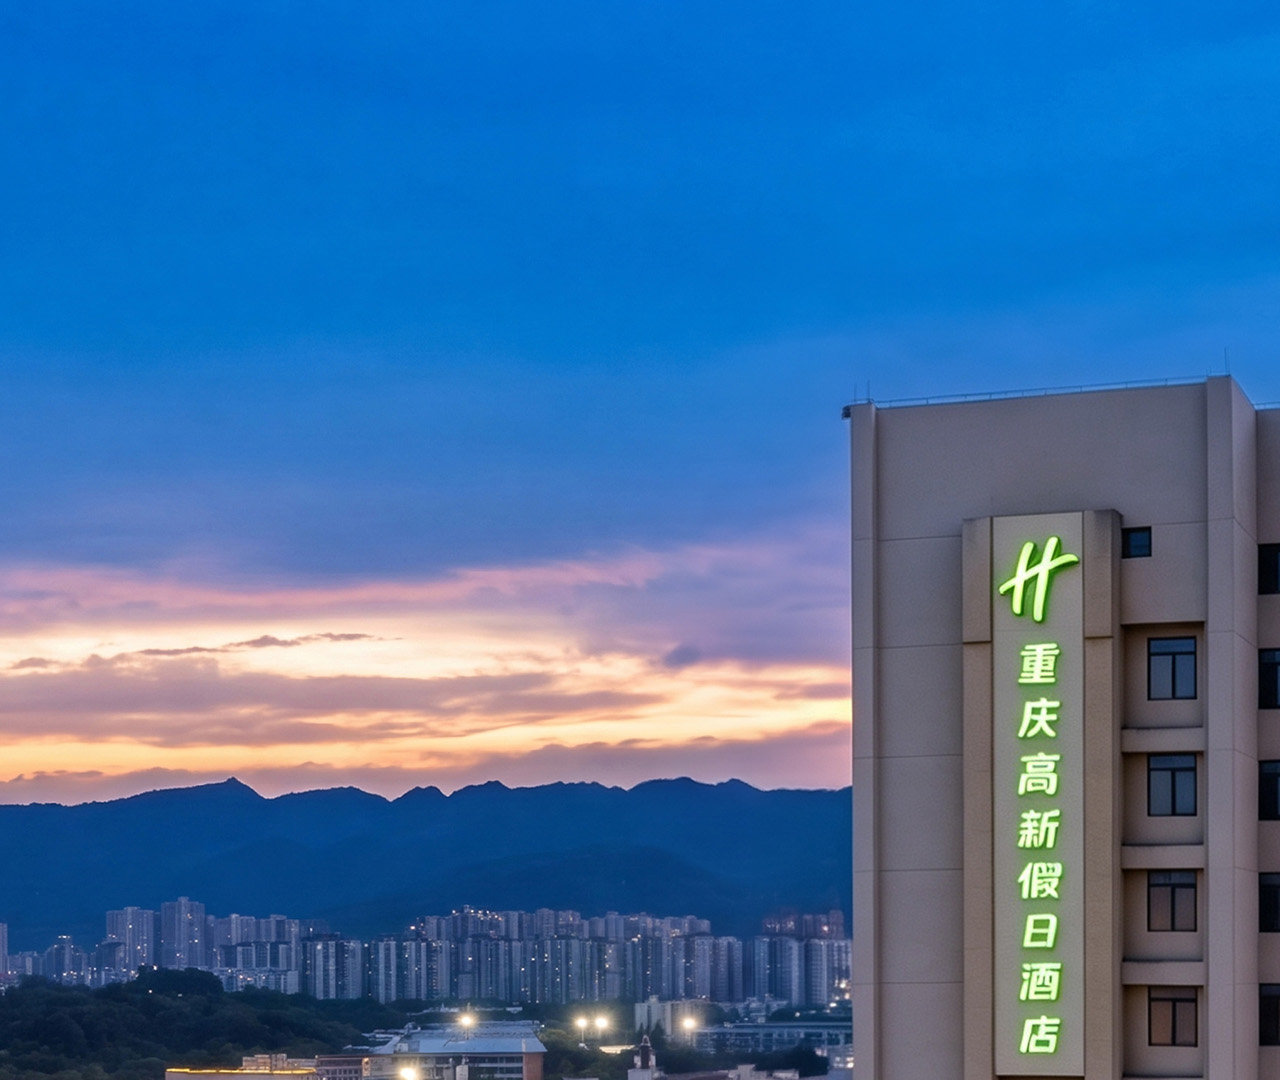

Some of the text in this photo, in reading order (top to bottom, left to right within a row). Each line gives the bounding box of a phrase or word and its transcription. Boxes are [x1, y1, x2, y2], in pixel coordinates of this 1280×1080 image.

[1017, 642, 1062, 1054] 重庆高新假日酒店
